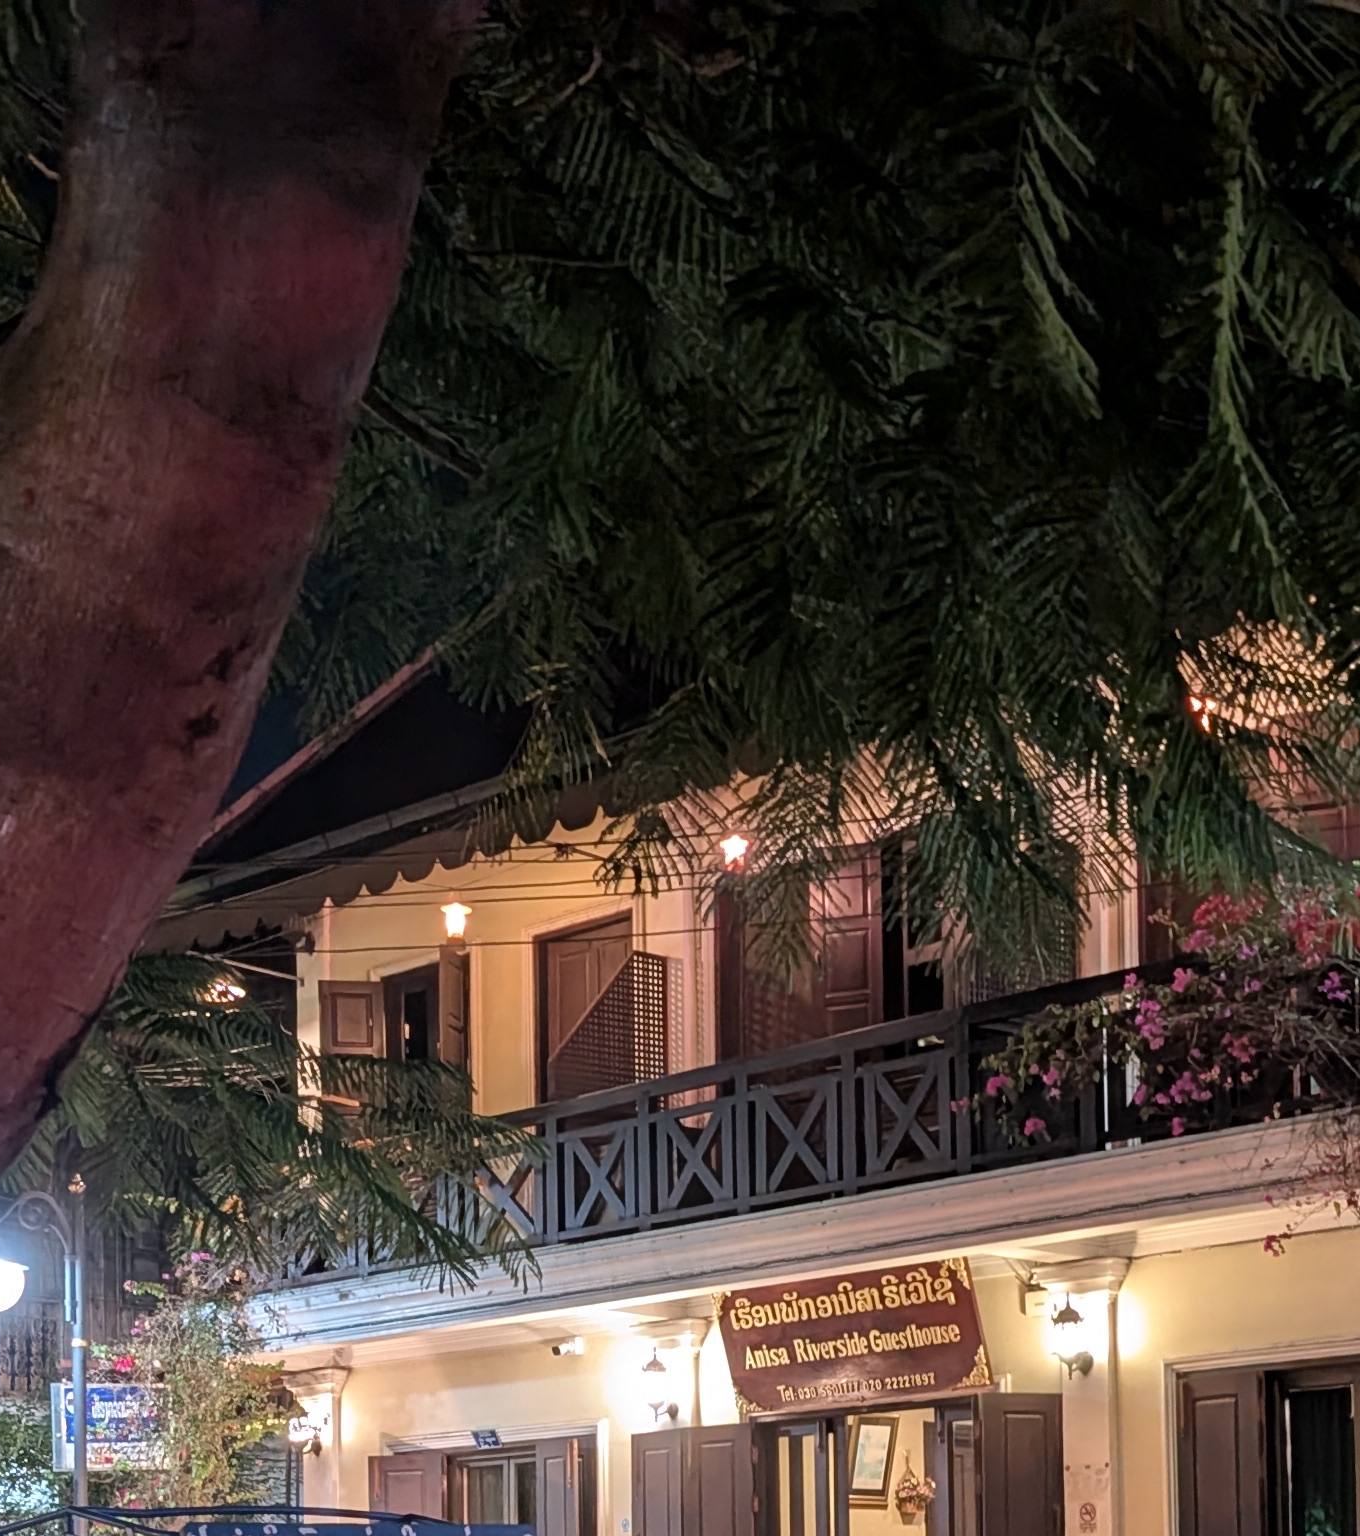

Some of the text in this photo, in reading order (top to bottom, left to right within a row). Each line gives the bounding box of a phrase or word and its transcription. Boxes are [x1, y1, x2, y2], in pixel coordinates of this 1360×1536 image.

[745, 1322, 961, 1370] Anisa Riverside Guesthouse
